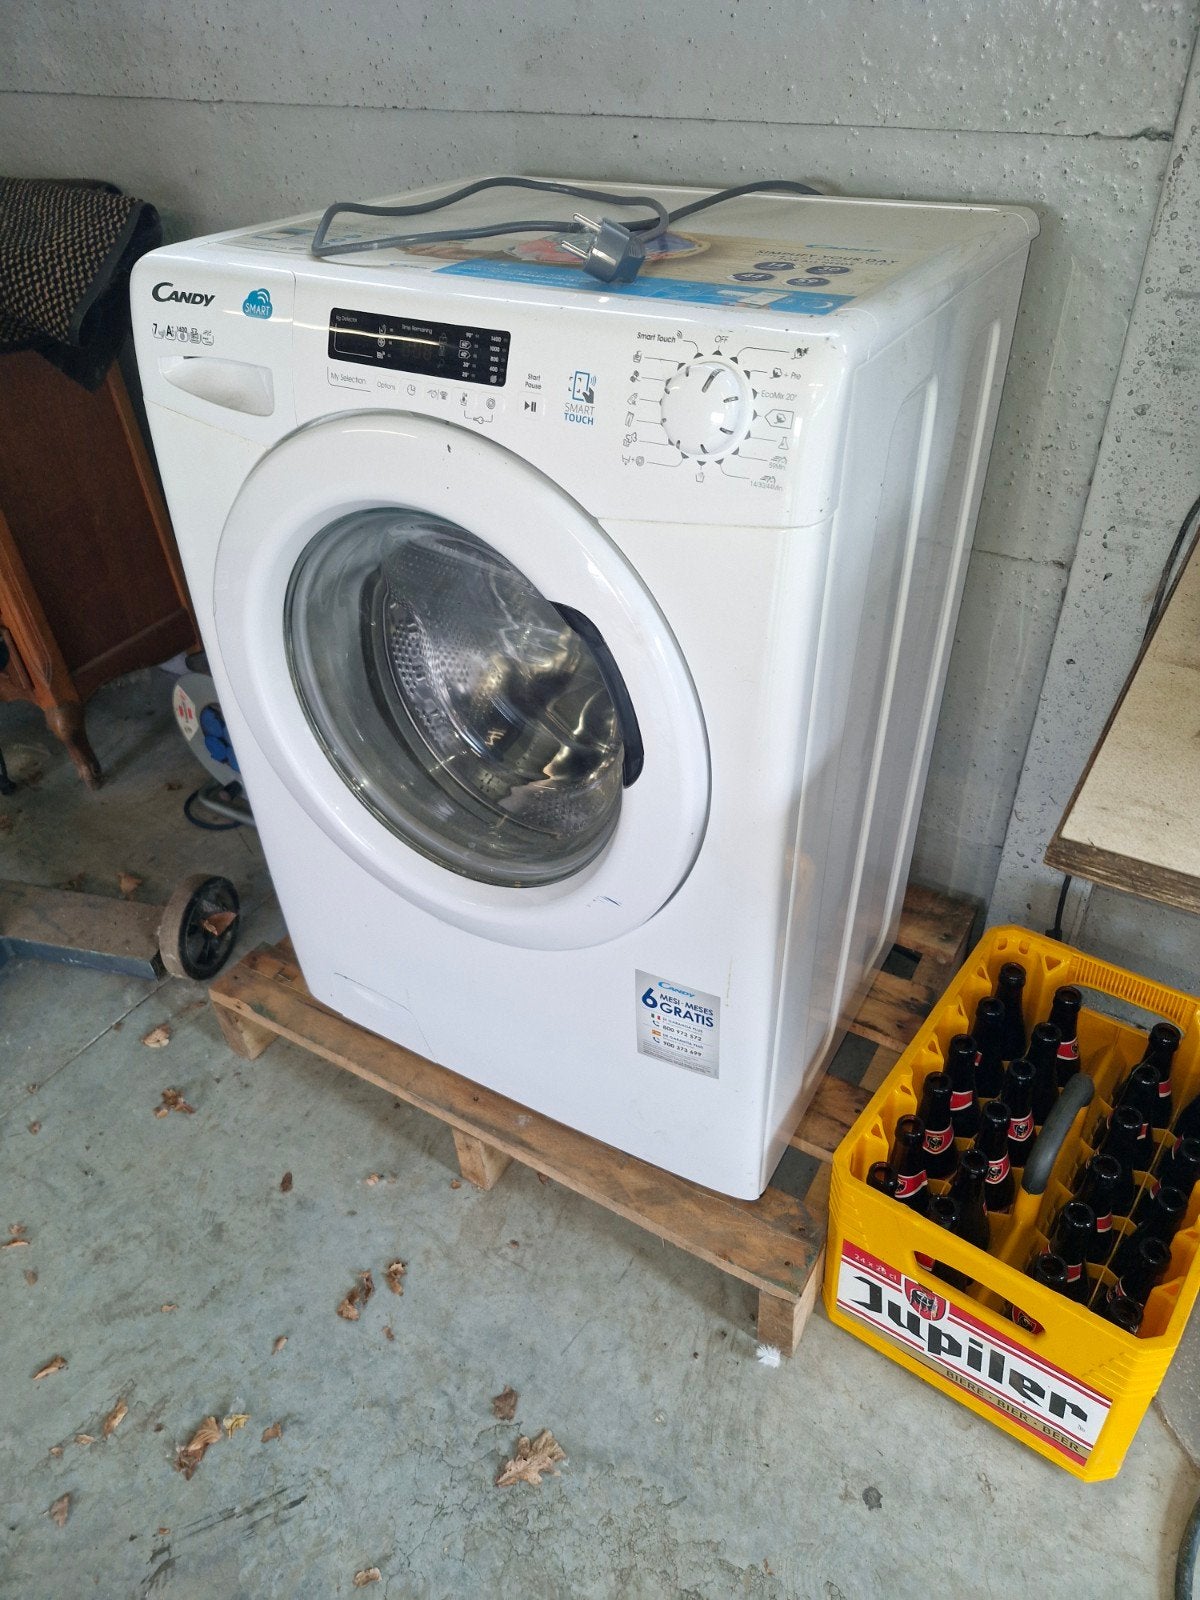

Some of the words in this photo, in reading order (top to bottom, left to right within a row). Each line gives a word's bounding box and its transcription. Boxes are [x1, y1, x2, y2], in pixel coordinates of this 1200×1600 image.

[152, 282, 216, 307] CANDY
[245, 302, 270, 316] SMART
[412, 325, 433, 335] Remaining
[637, 332, 655, 342] Smart
[657, 334, 676, 343] Touch
[714, 335, 728, 343] OFF
[331, 372, 339, 380] My
[340, 374, 366, 384] Selection
[377, 382, 396, 390] Options
[525, 382, 542, 390] Pause
[761, 390, 784, 399] EcoMix
[565, 403, 595, 415] SMART
[564, 413, 594, 425] TOUCH
[658, 981, 695, 998] CANDY
[642, 987, 658, 1008] 6
[660, 994, 680, 1005] MESI
[685, 1002, 714, 1016] MESES
[660, 1002, 714, 1028] GRATIS
[854, 1253, 865, 1263] 24
[847, 1276, 1088, 1422] Jupiler
[946, 1369, 984, 1398] BIERE
[996, 1399, 1029, 1423] BIER
[1042, 1424, 1080, 1453] BEER
